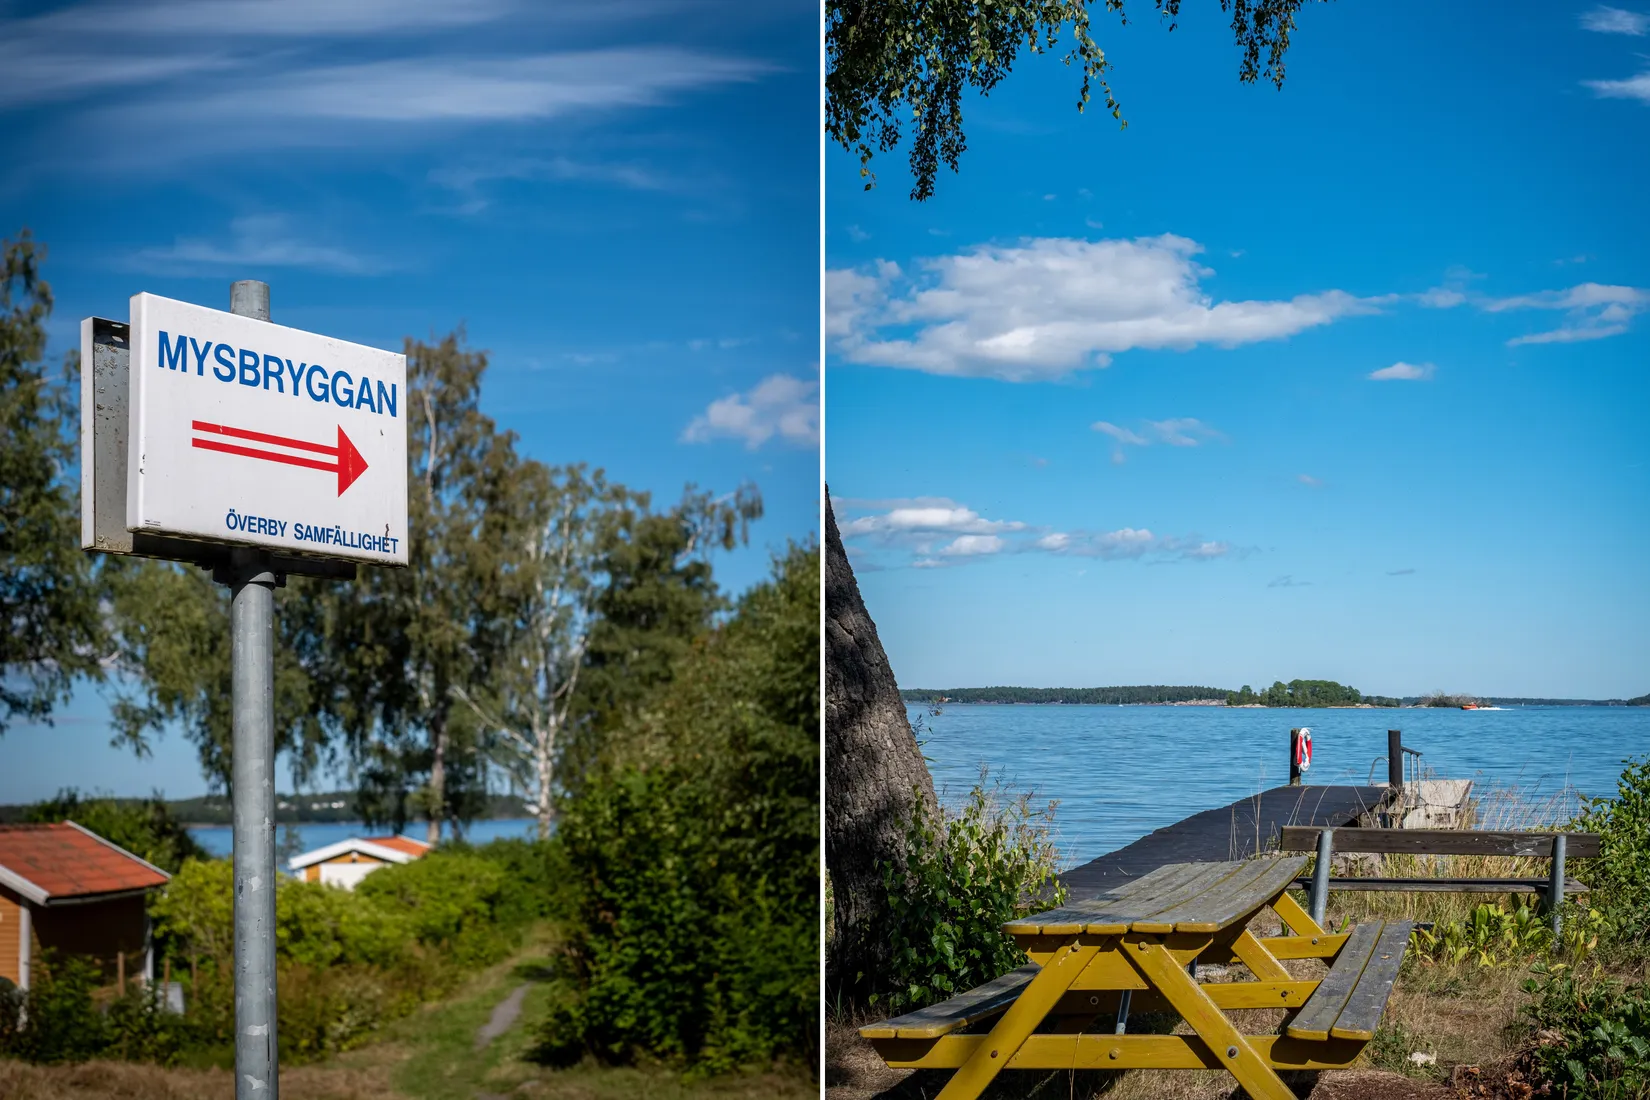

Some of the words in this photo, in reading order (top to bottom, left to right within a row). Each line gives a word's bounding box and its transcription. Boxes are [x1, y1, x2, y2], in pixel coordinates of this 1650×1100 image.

[158, 330, 397, 418] MYSBRYGGAN
[226, 508, 287, 537] ÖVERBY
[294, 523, 399, 554] SAMFÄLLIGHET
